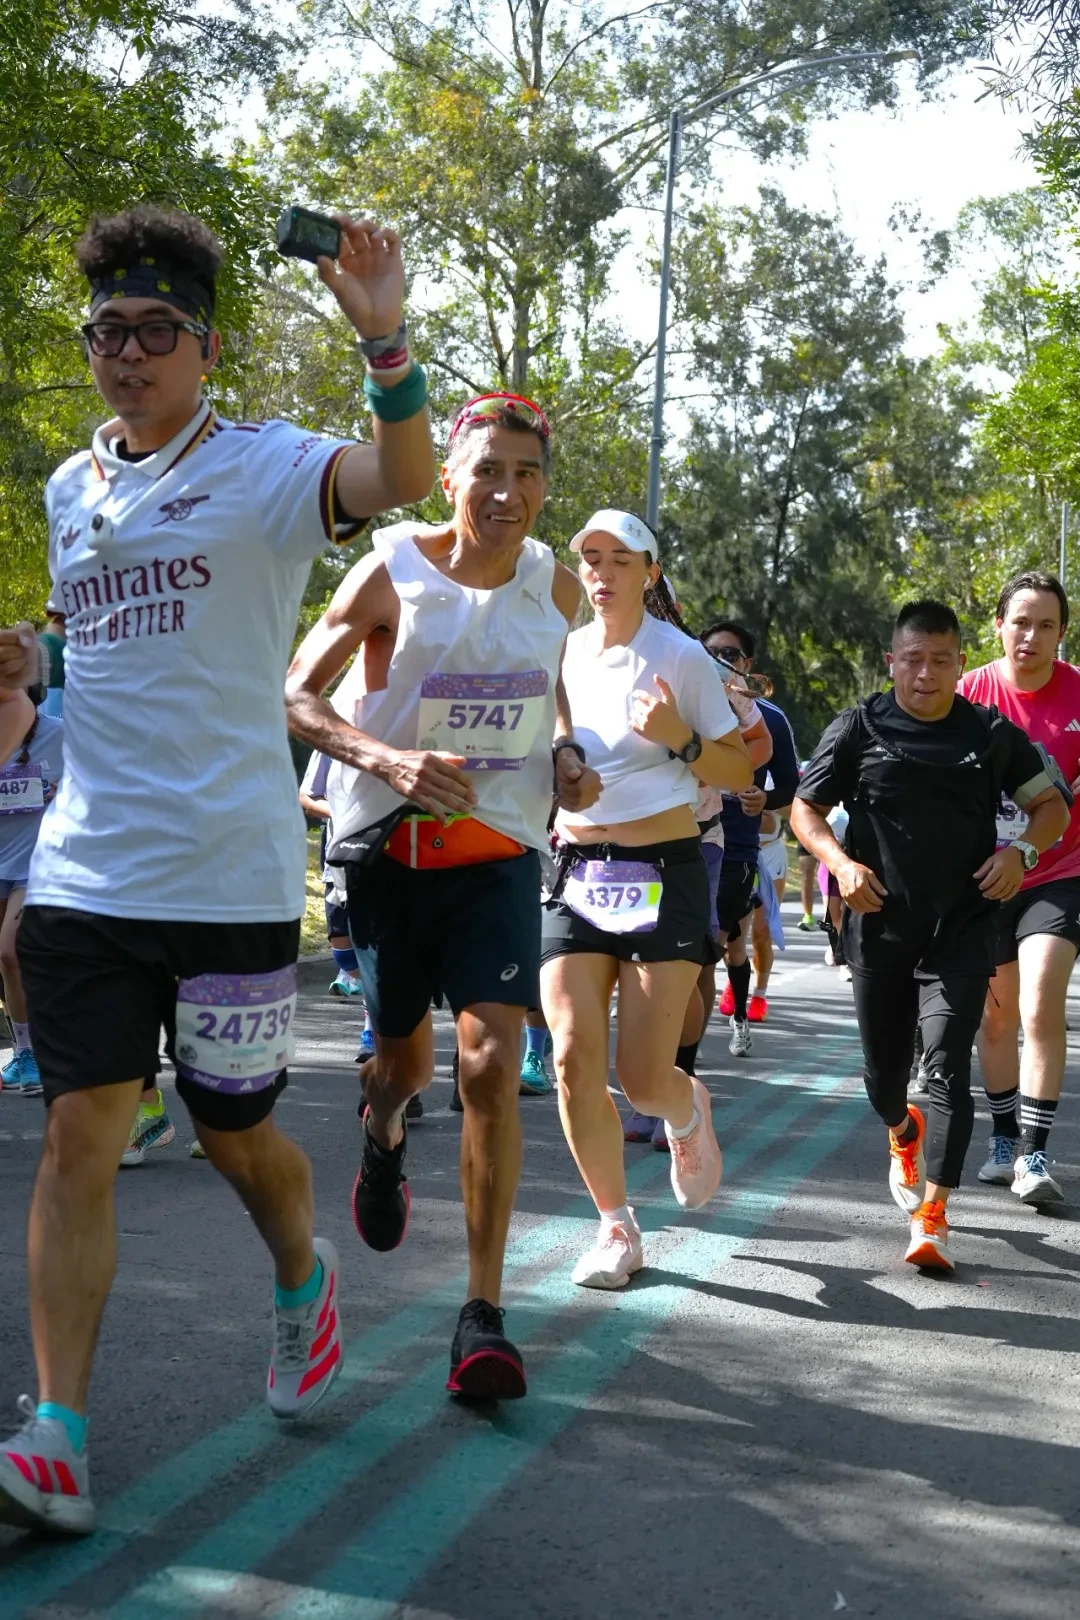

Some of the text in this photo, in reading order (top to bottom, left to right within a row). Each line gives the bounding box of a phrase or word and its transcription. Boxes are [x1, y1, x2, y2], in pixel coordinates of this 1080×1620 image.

[61, 555, 212, 618] Emirates
[108, 600, 185, 643] BETTER
[447, 703, 524, 731] 5747
[0, 780, 30, 795] 487
[195, 1003, 292, 1045] 24739
